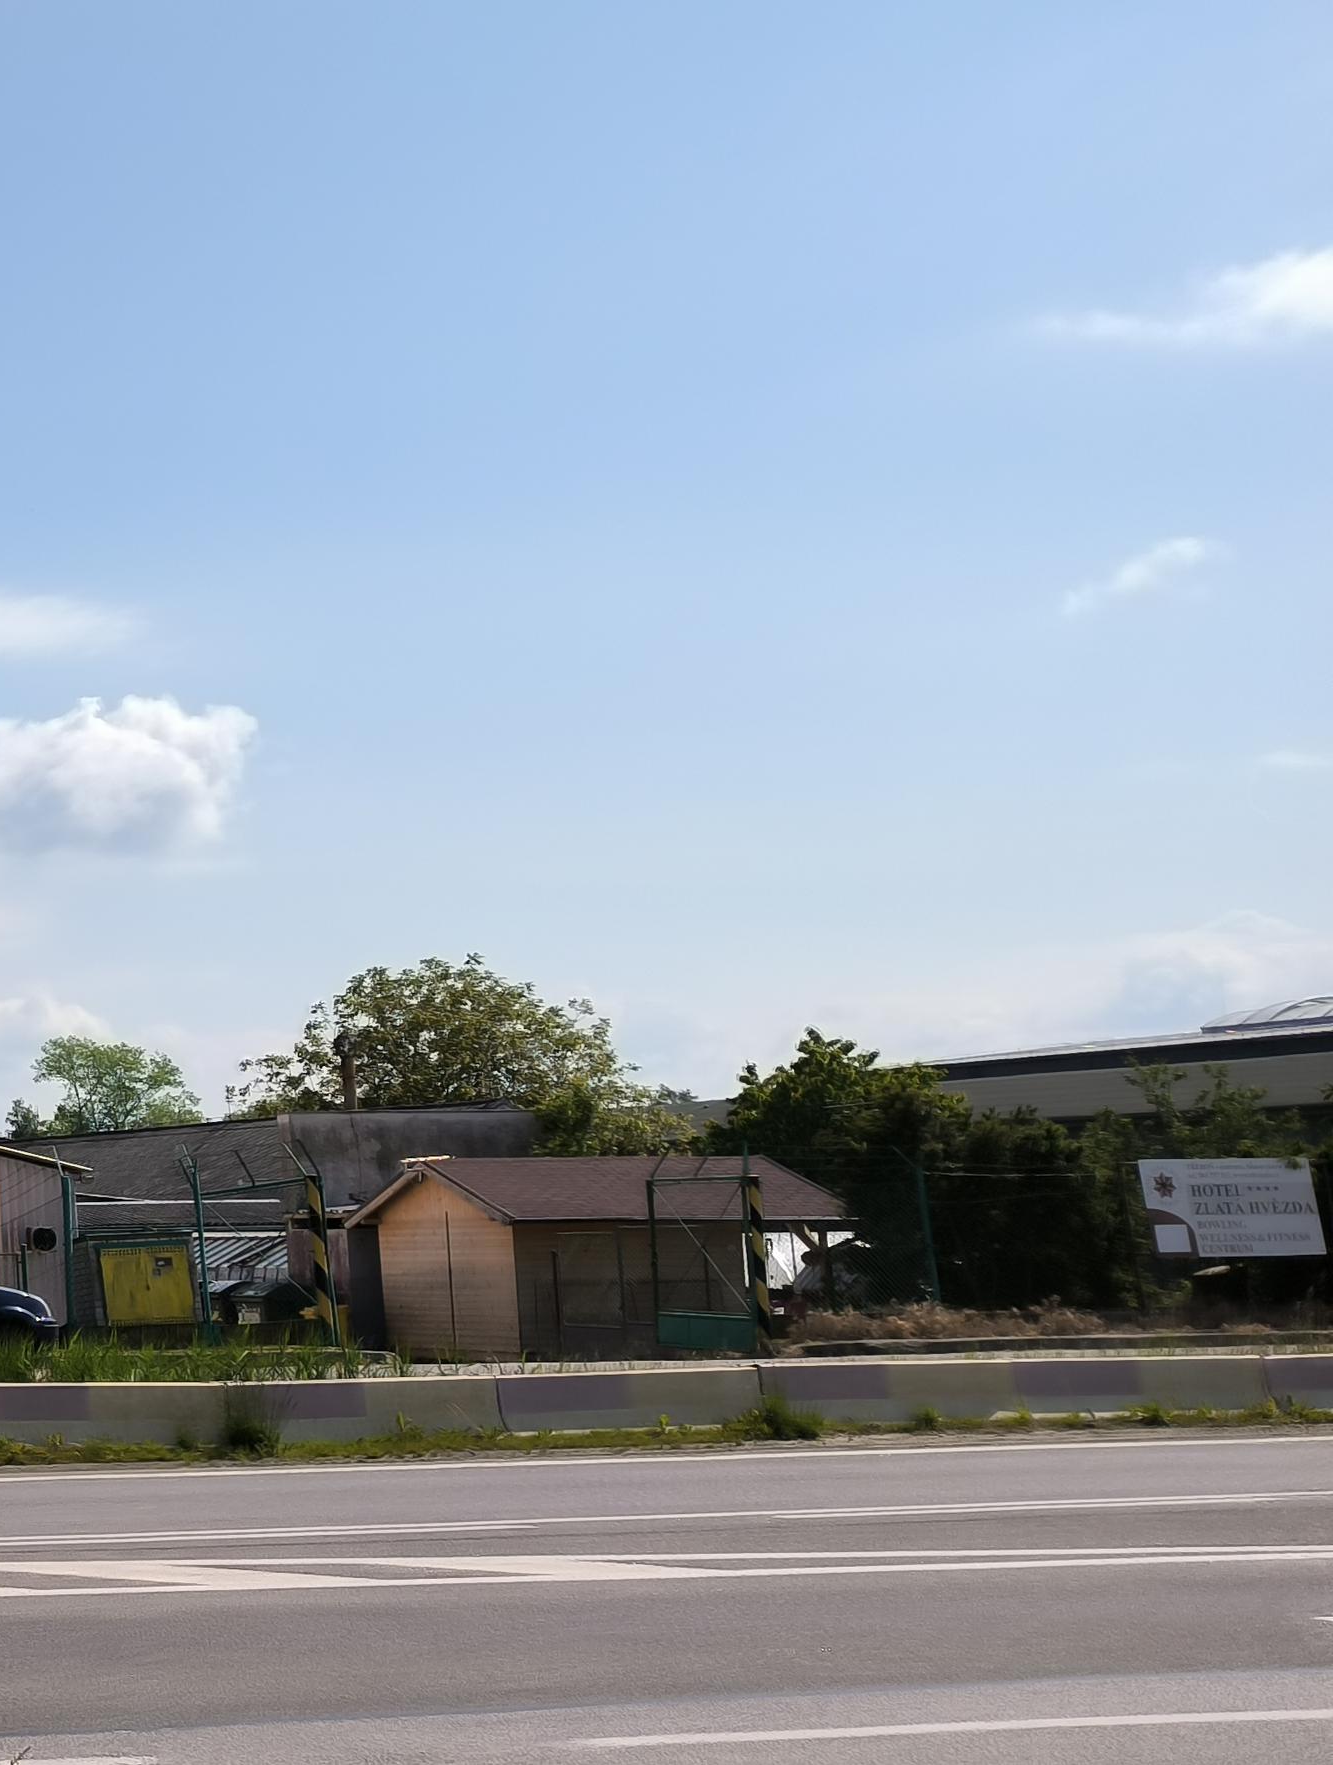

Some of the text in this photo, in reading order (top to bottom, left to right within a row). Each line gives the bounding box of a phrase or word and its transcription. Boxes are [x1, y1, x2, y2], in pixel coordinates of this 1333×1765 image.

[1190, 1184, 1244, 1198] HOTEL
[1194, 1198, 1316, 1215] ZLATÁ HVĚZDA
